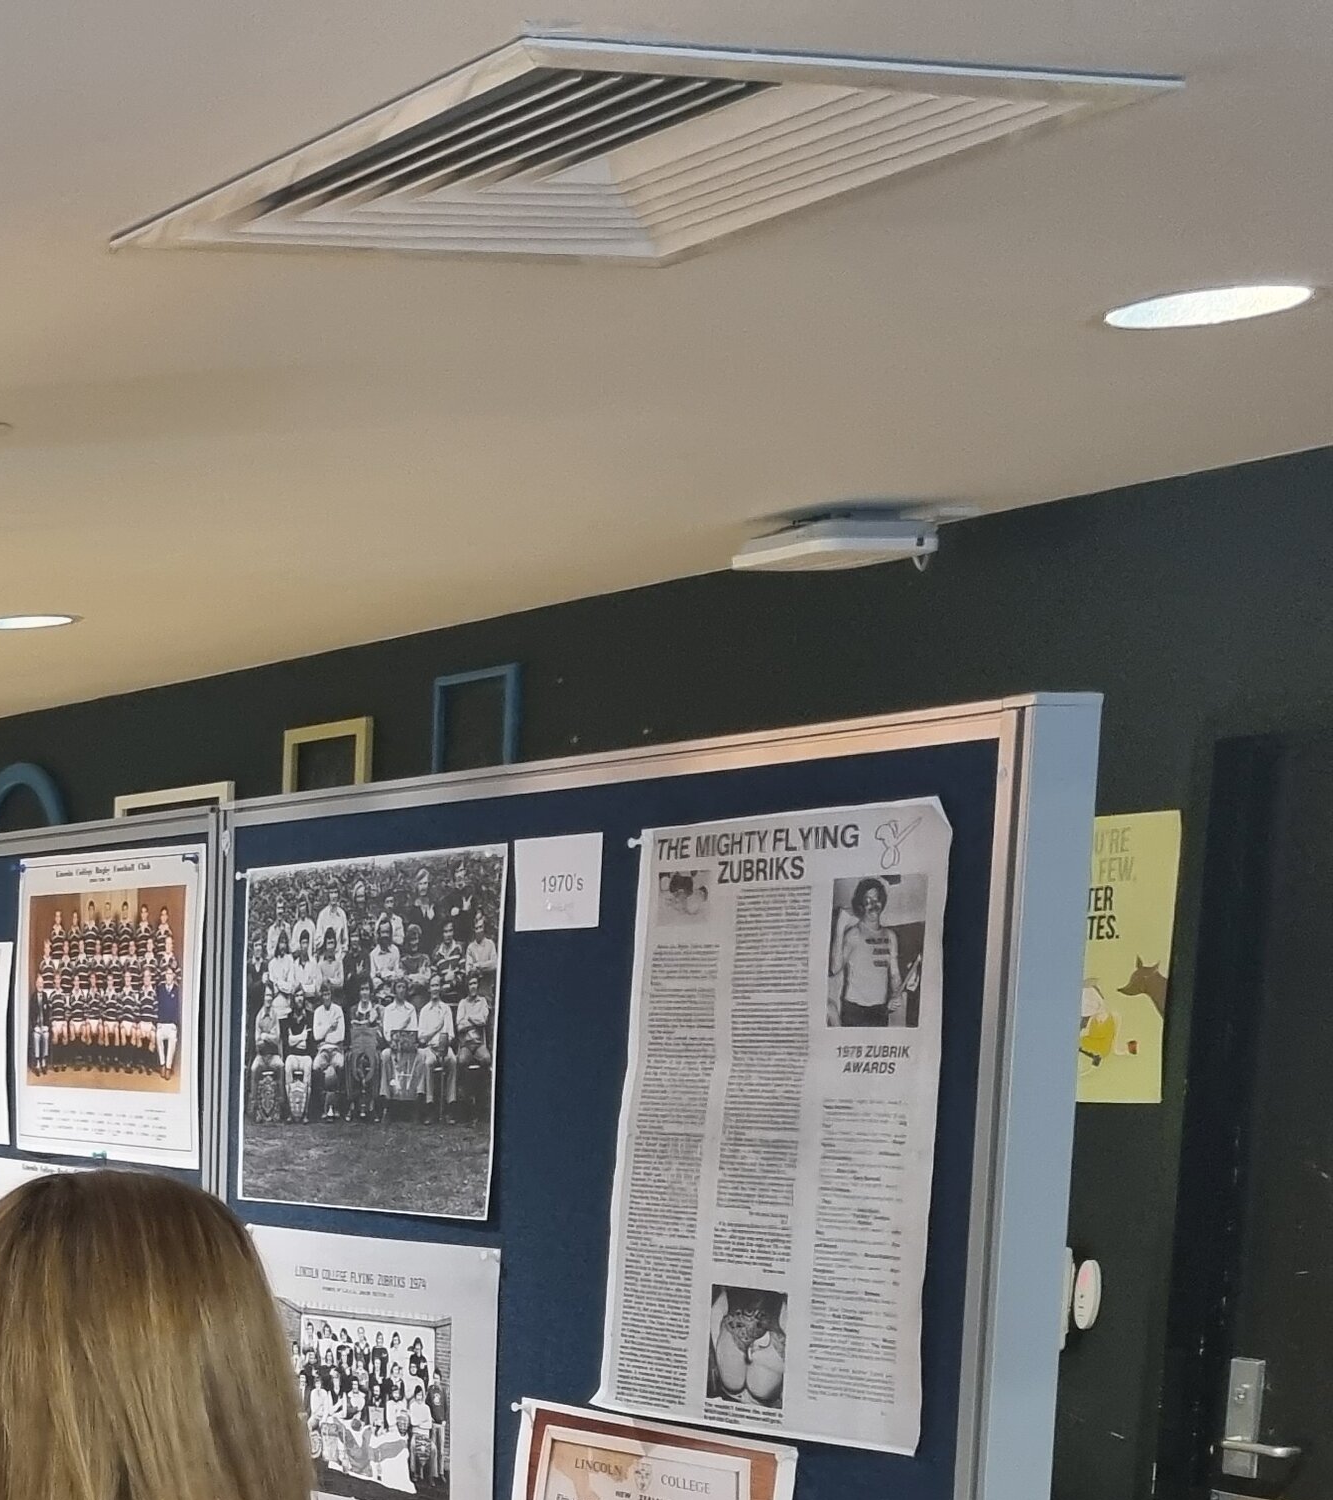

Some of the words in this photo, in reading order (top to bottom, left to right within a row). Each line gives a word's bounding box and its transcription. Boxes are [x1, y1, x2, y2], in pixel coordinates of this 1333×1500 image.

[658, 836, 691, 861] THE
[695, 829, 768, 858] MIGHTY
[772, 823, 860, 853] FLYING
[717, 855, 805, 885] ZUBRIKS
[541, 873, 584, 893] 1970's
[865, 1045, 911, 1058] ZUBRIK
[842, 1061, 896, 1074] AWARDS
[574, 1457, 623, 1476] LINCOLN
[660, 1474, 711, 1495] COLLEGE
[615, 1490, 631, 1499] NEW
